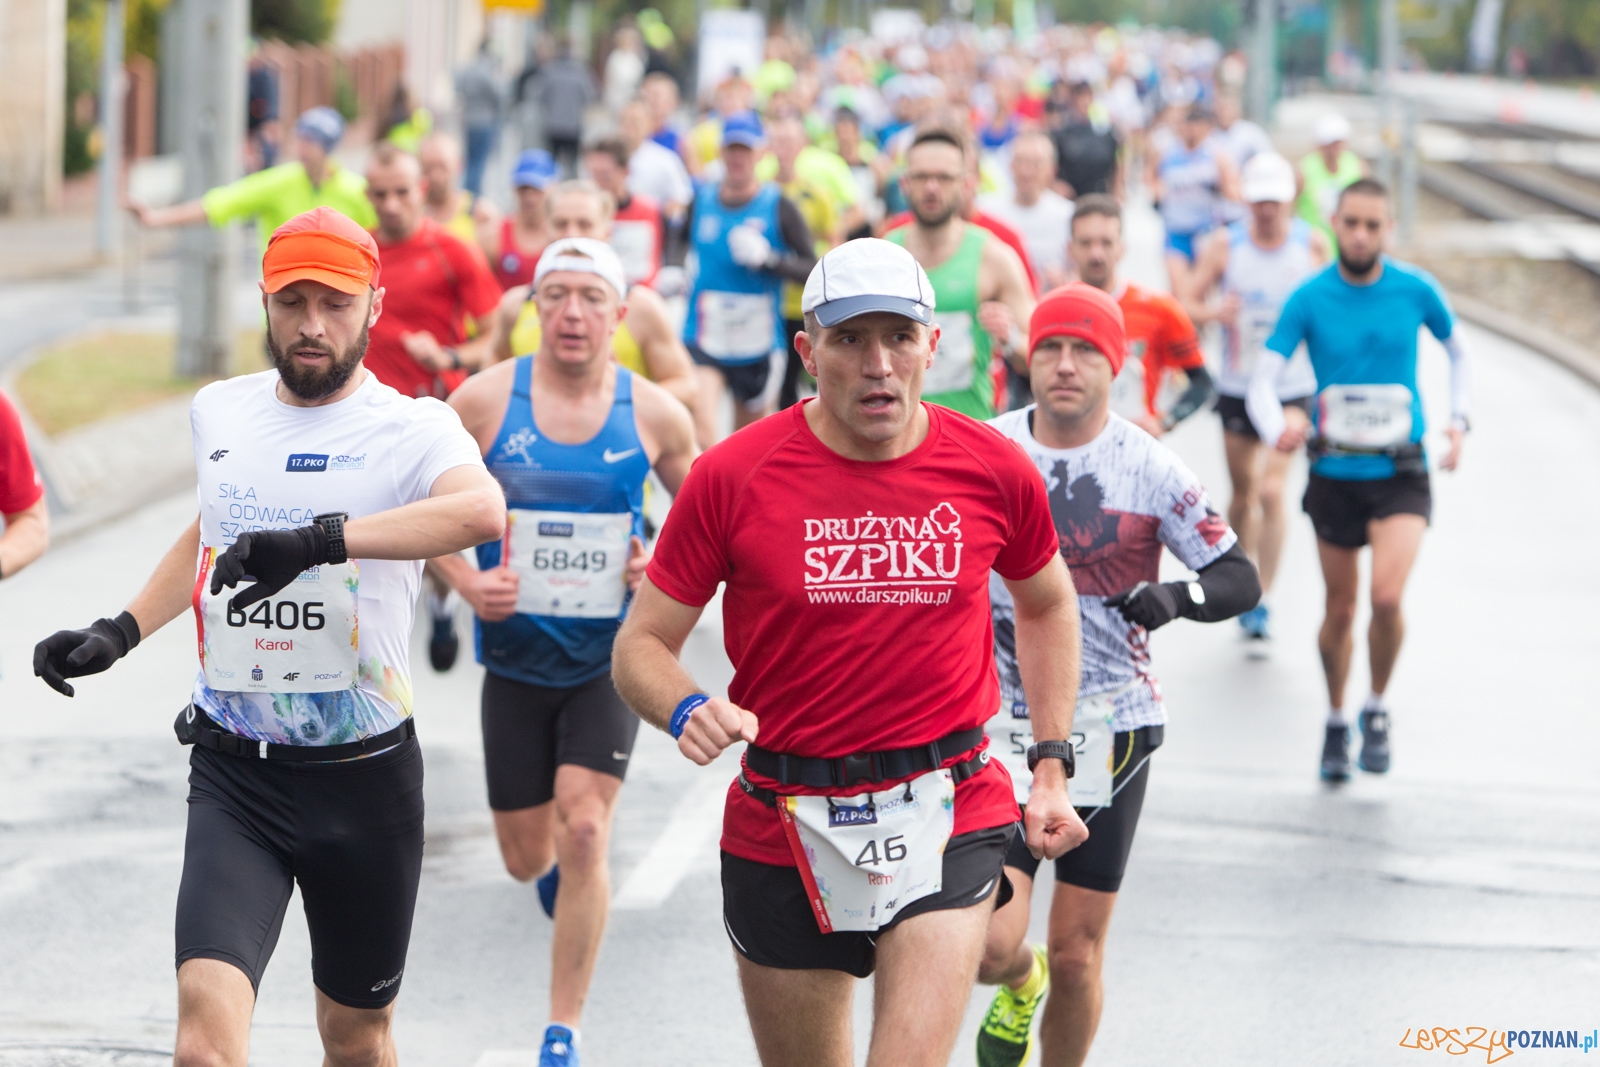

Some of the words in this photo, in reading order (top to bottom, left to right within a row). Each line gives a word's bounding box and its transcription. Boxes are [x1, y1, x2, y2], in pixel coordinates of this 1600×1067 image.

[303, 458, 325, 467] PKO
[218, 483, 257, 501] SIŁA
[229, 503, 315, 524] ODWAGA
[803, 510, 938, 542] DRUŻYNA
[533, 548, 607, 573] 6849
[803, 540, 964, 584] SZPIKU
[807, 587, 952, 607] www.darszpiku.pl
[226, 598, 325, 631] 6406
[255, 637, 293, 651] Karol
[855, 834, 907, 867] 46
